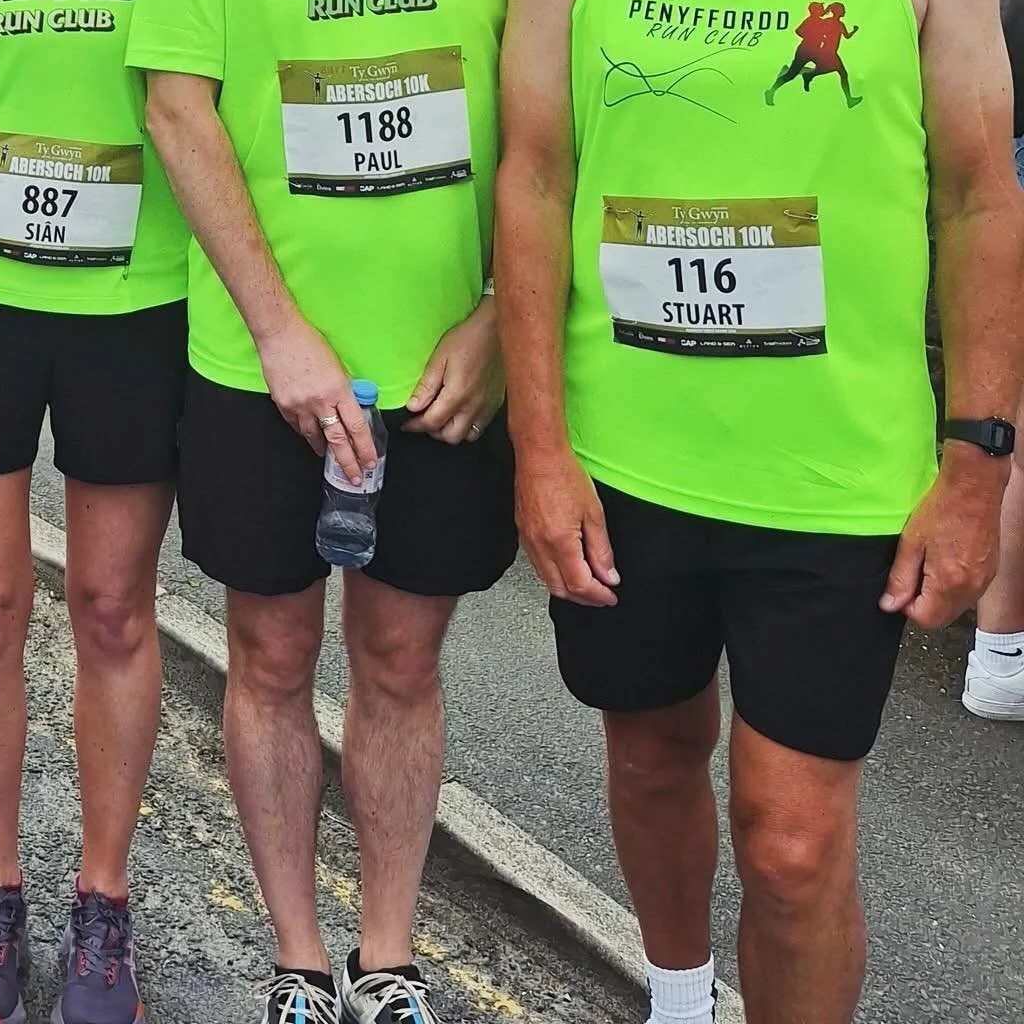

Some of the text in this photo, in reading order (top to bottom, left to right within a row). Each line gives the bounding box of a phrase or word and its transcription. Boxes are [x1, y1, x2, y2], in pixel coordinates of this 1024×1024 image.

[48, 9, 115, 32] CLUB
[629, 0, 789, 30] PENYFFORDD
[646, 23, 762, 47] RUN CLUB
[349, 62, 399, 79] Ty Gwyn
[326, 74, 431, 103] ABERSOCH 10K
[337, 106, 413, 144] 1188
[36, 143, 50, 156] Ty
[51, 145, 82, 161] Gwyn
[354, 150, 402, 172] PAUL
[9, 157, 112, 182] ABERSOCH 10K
[22, 185, 78, 217] 887
[672, 207, 729, 224] Ty Gwyn
[25, 221, 66, 243] SIÂN
[646, 225, 775, 247] ABERSOCH 10K
[668, 257, 737, 294] 116
[662, 301, 745, 326] STUART
